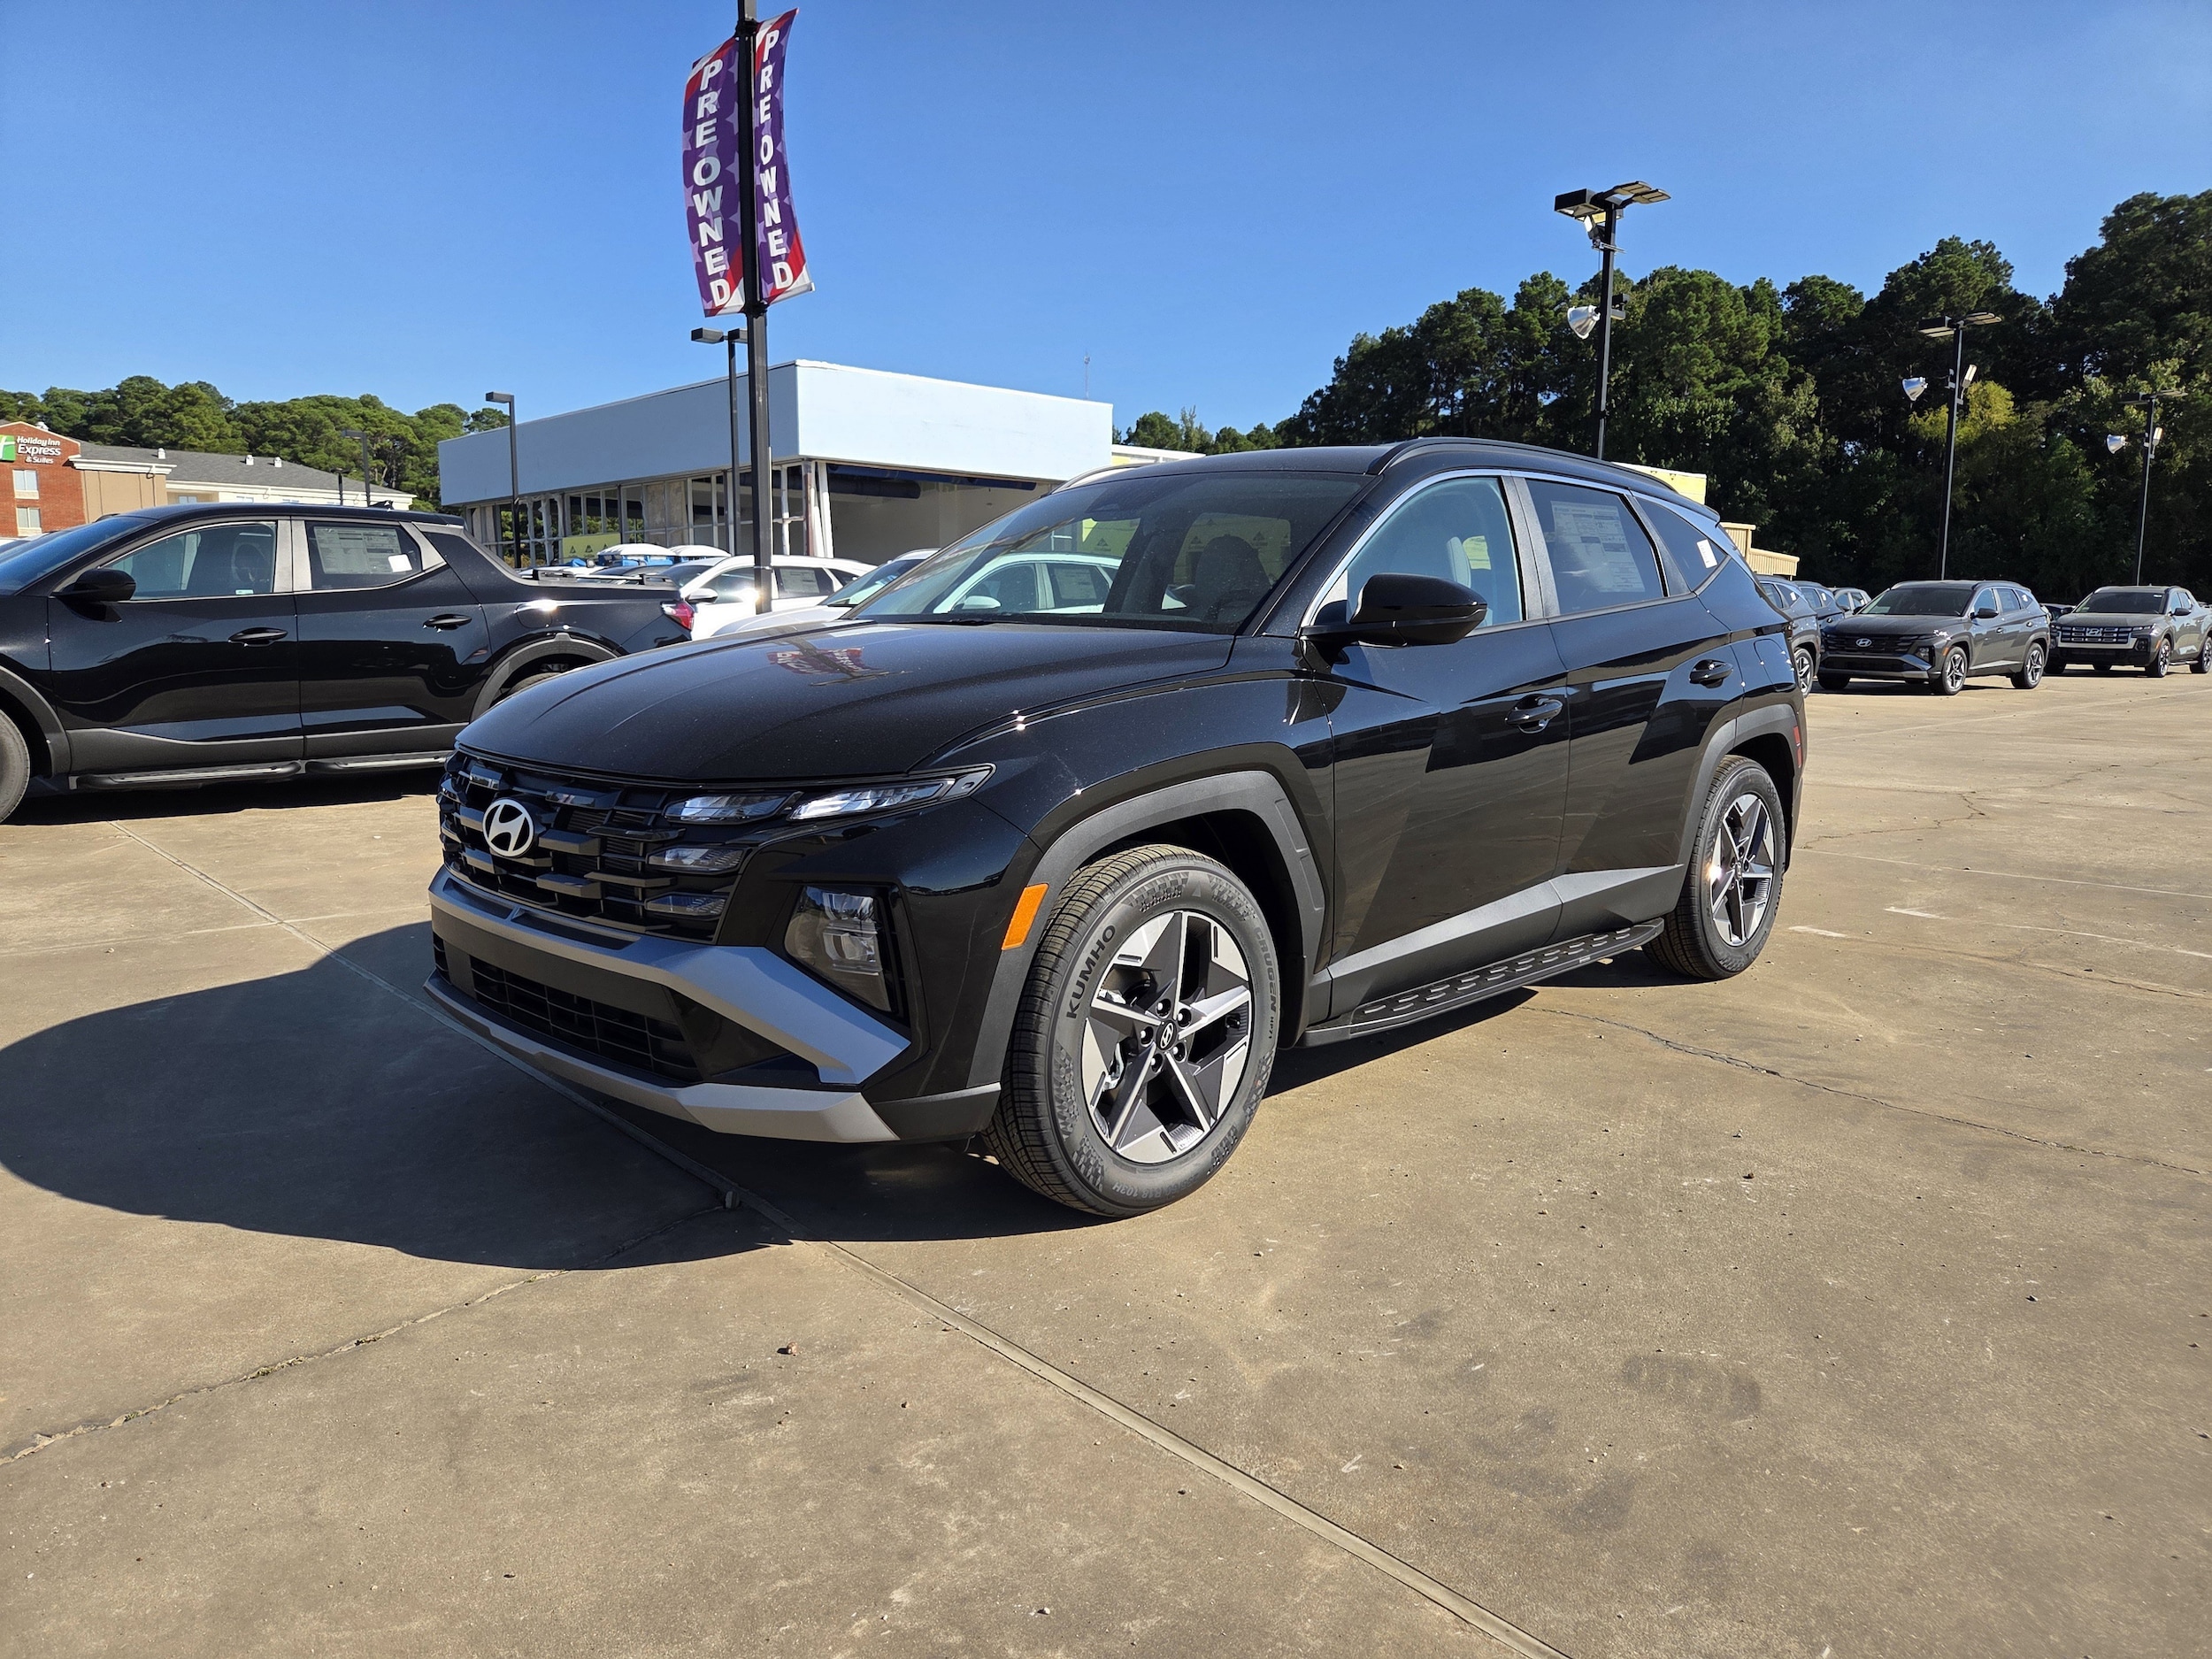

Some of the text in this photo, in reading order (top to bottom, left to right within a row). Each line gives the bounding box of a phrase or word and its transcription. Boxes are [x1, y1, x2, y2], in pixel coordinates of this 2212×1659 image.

[17, 435, 48, 446] Holiday
[18, 444, 61, 456] Express
[1066, 925, 1116, 1019] KUMHO
[1111, 1181, 1139, 1198] 103H
